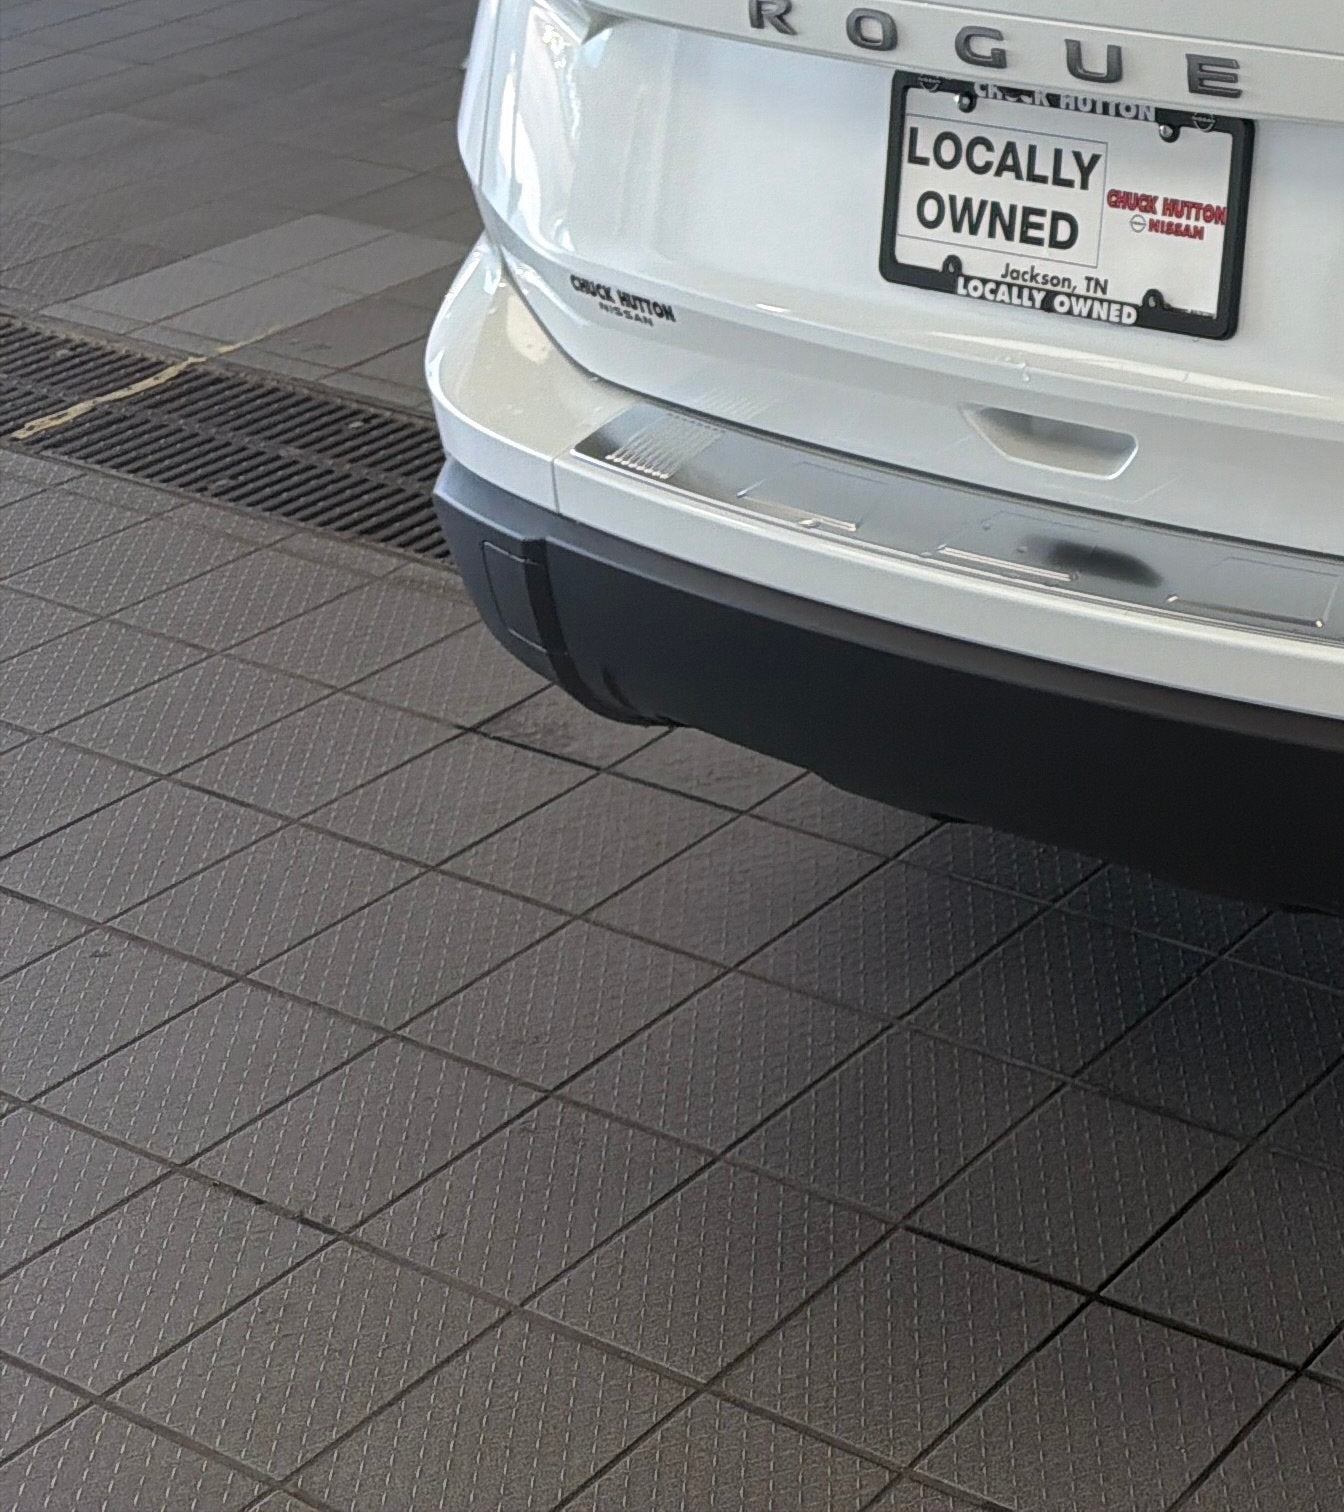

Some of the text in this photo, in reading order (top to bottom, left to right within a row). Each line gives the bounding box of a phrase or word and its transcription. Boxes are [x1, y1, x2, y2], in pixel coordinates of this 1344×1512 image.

[1060, 92, 1156, 122] HUTTON
[907, 126, 1102, 191] LOCALLY
[916, 190, 1079, 251] OWNED
[1106, 189, 1227, 225] CHUCK HUTTON
[1148, 218, 1204, 241] NISSAN
[570, 274, 676, 322] CHUCK HUTTON
[1001, 263, 1108, 296] Jackson, TN
[956, 276, 1138, 326] LOCALLY OWNED
